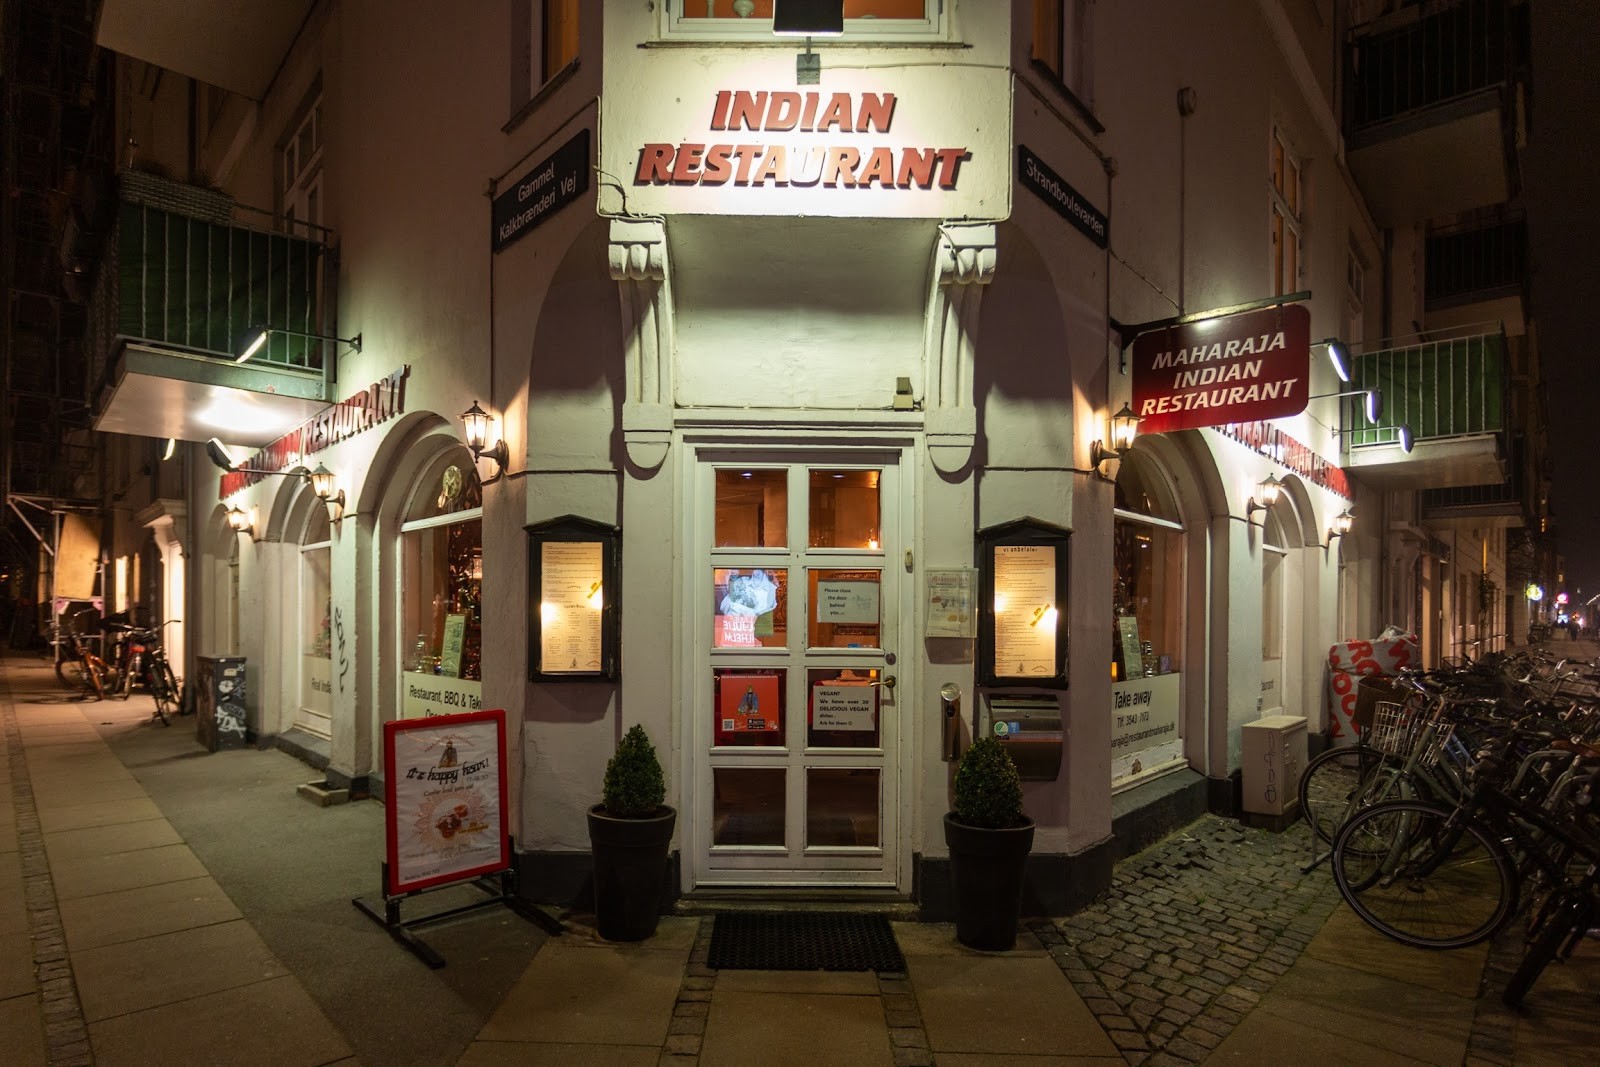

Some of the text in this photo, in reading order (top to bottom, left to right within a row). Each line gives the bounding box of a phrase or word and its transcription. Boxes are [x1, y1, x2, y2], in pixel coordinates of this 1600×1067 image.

[711, 91, 897, 132] INDIAN
[518, 162, 555, 202] Gammel
[635, 143, 969, 190] RESTAURANT
[500, 170, 576, 242] Kalkbrænderi Vej
[1026, 158, 1104, 237] Strandboulevarden
[1152, 332, 1286, 370] MAHARAJA
[1173, 360, 1263, 390] INDIAN
[304, 364, 411, 456] RESTAURANT
[1141, 378, 1298, 416] RESTAURANT
[409, 685, 442, 704] Restaurant,
[444, 690, 459, 707] BBQ
[461, 693, 466, 708] &
[1115, 690, 1152, 709] Take away
[427, 766, 459, 785] happy
[462, 758, 489, 776] hour!
